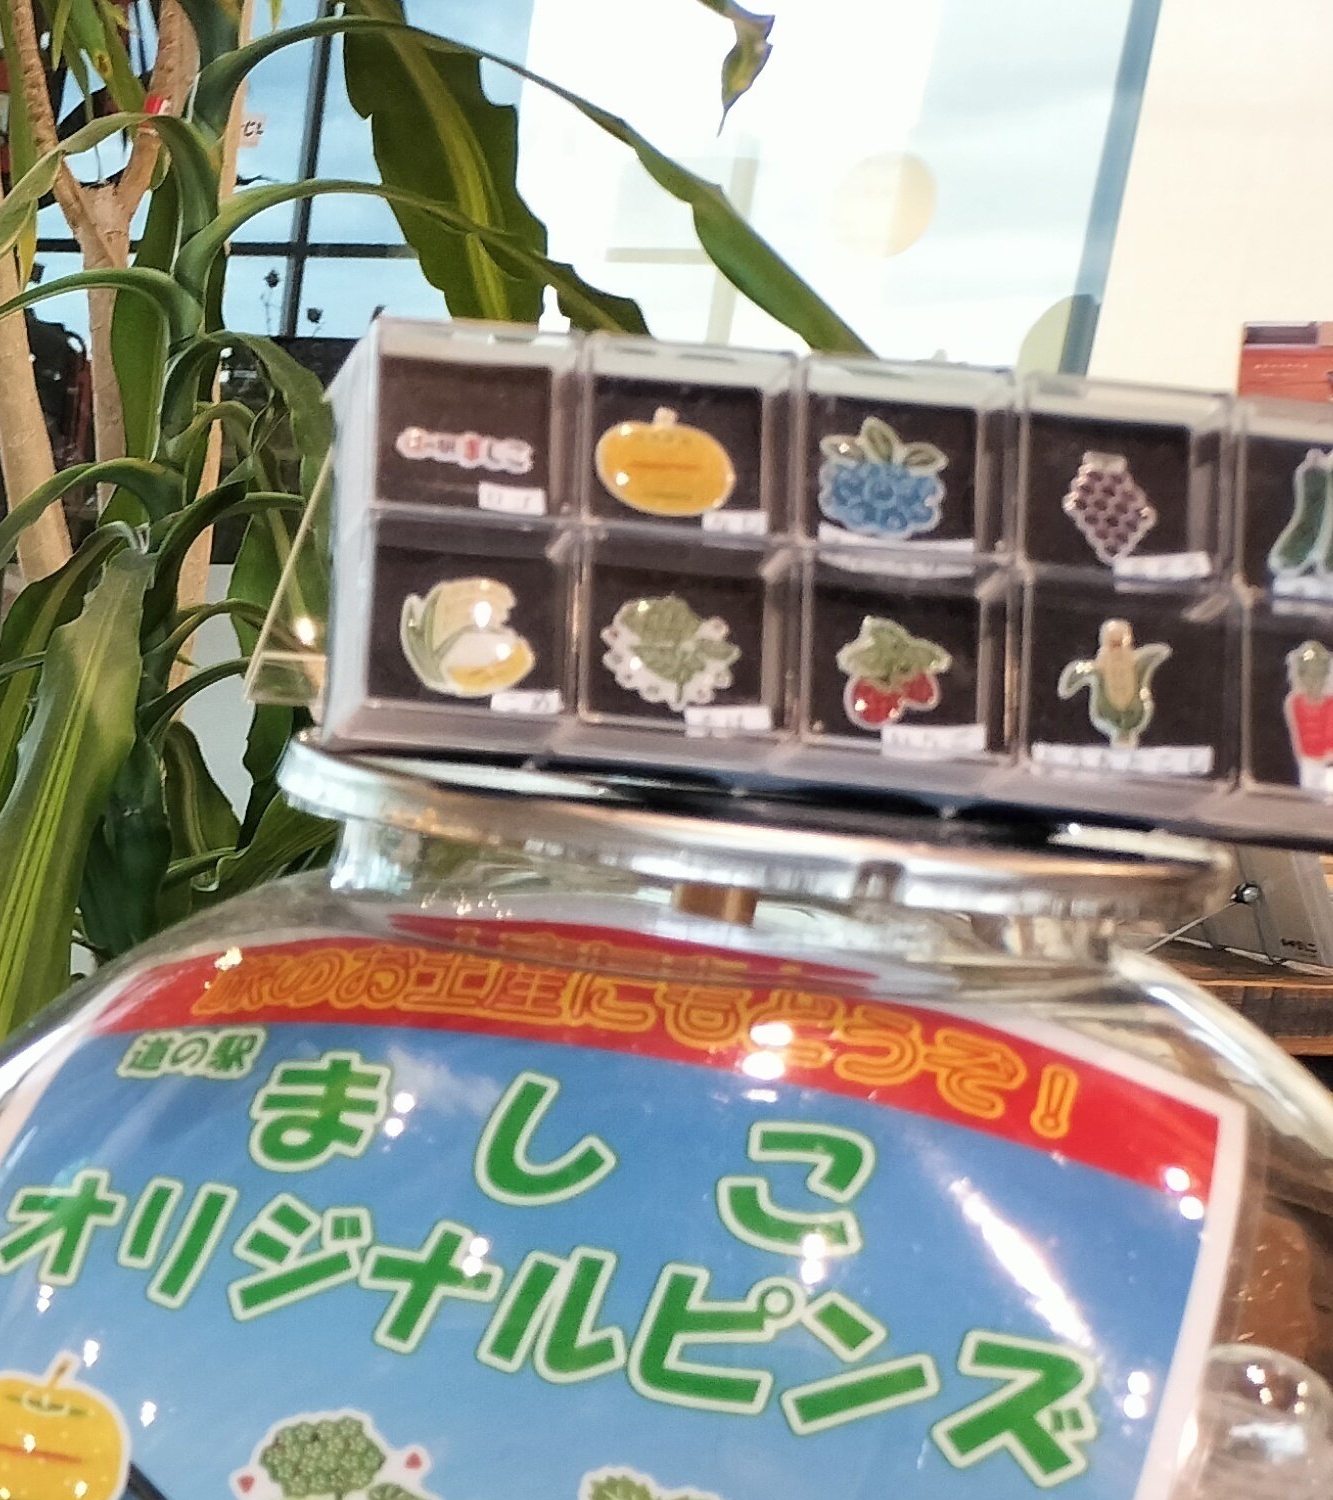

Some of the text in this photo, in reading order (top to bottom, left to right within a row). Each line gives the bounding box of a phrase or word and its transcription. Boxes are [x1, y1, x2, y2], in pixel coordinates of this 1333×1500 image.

[121, 1028, 266, 1078] 道の駅
[249, 1050, 875, 1255] ましこ
